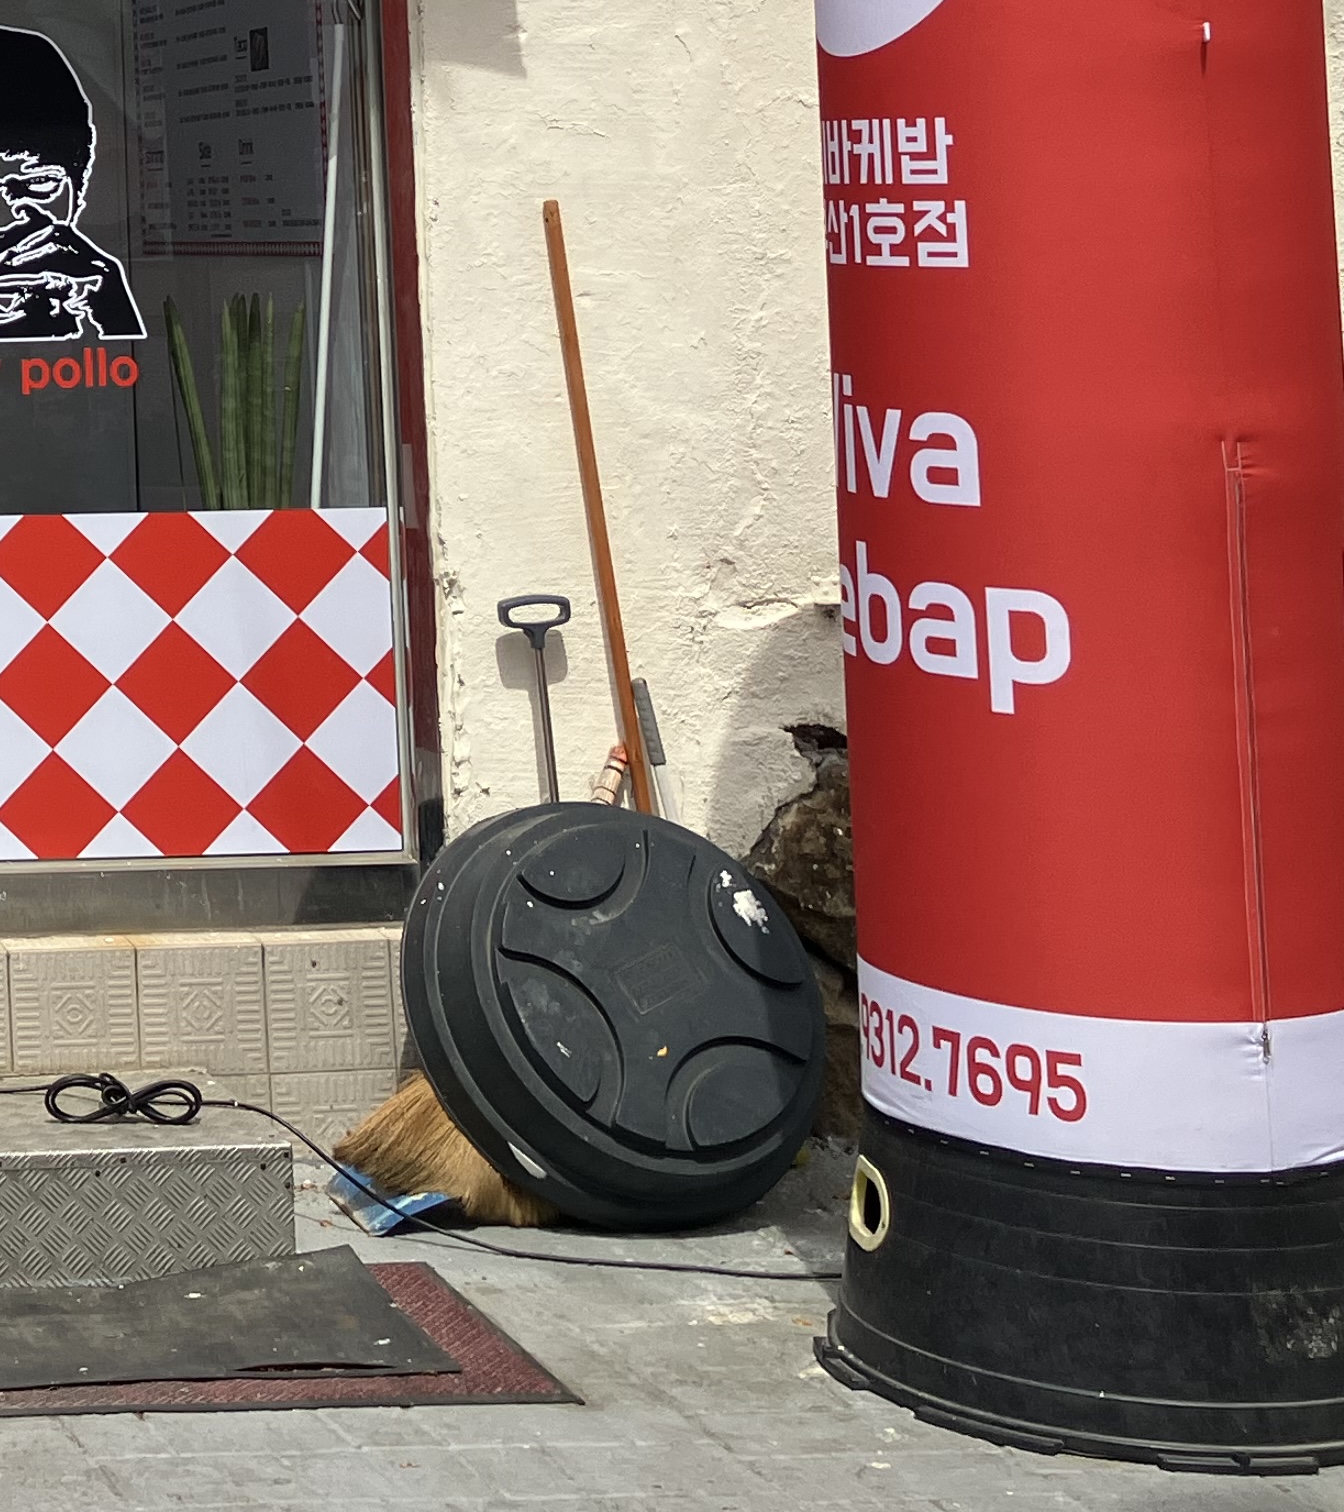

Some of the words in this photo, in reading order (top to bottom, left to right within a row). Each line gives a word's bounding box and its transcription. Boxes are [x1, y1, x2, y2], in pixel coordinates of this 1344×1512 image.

[822, 117, 954, 184] 바케밥
[824, 198, 970, 268] 산1호점
[20, 346, 139, 394] pollo
[833, 373, 981, 507] iva
